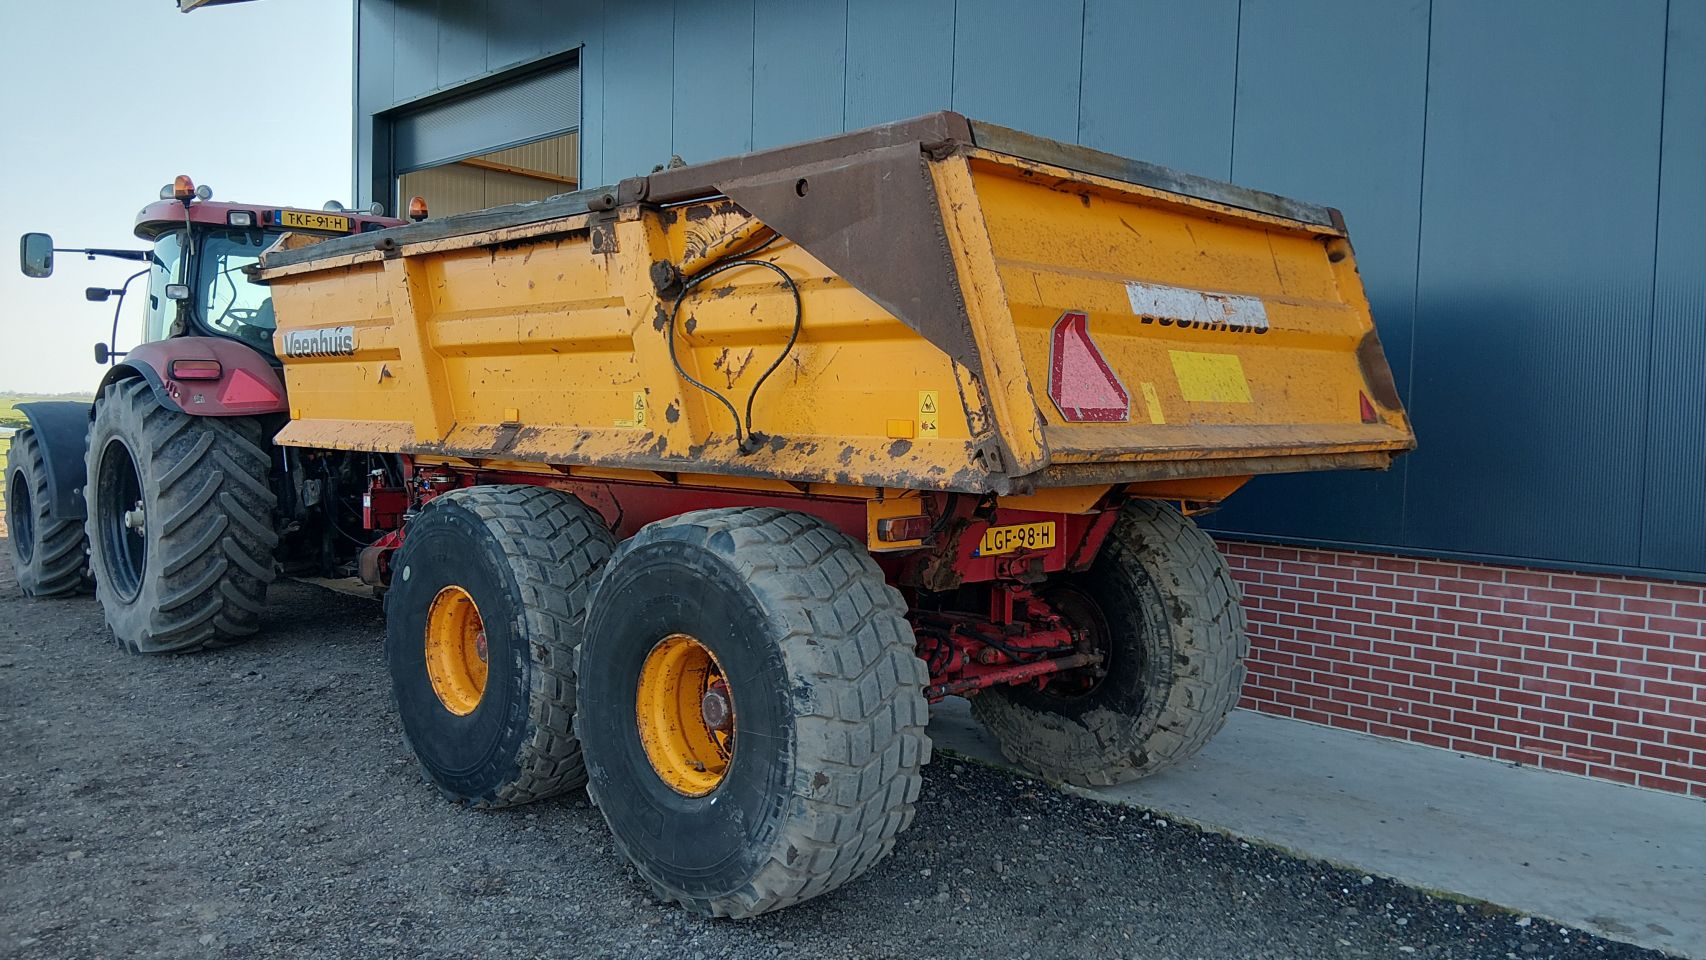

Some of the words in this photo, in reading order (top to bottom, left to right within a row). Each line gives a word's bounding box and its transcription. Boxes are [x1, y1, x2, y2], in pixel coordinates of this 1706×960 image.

[288, 213, 342, 229] TKF-91-H
[284, 326, 354, 358] Veenhuis
[985, 525, 1050, 551] LGF-98-H
